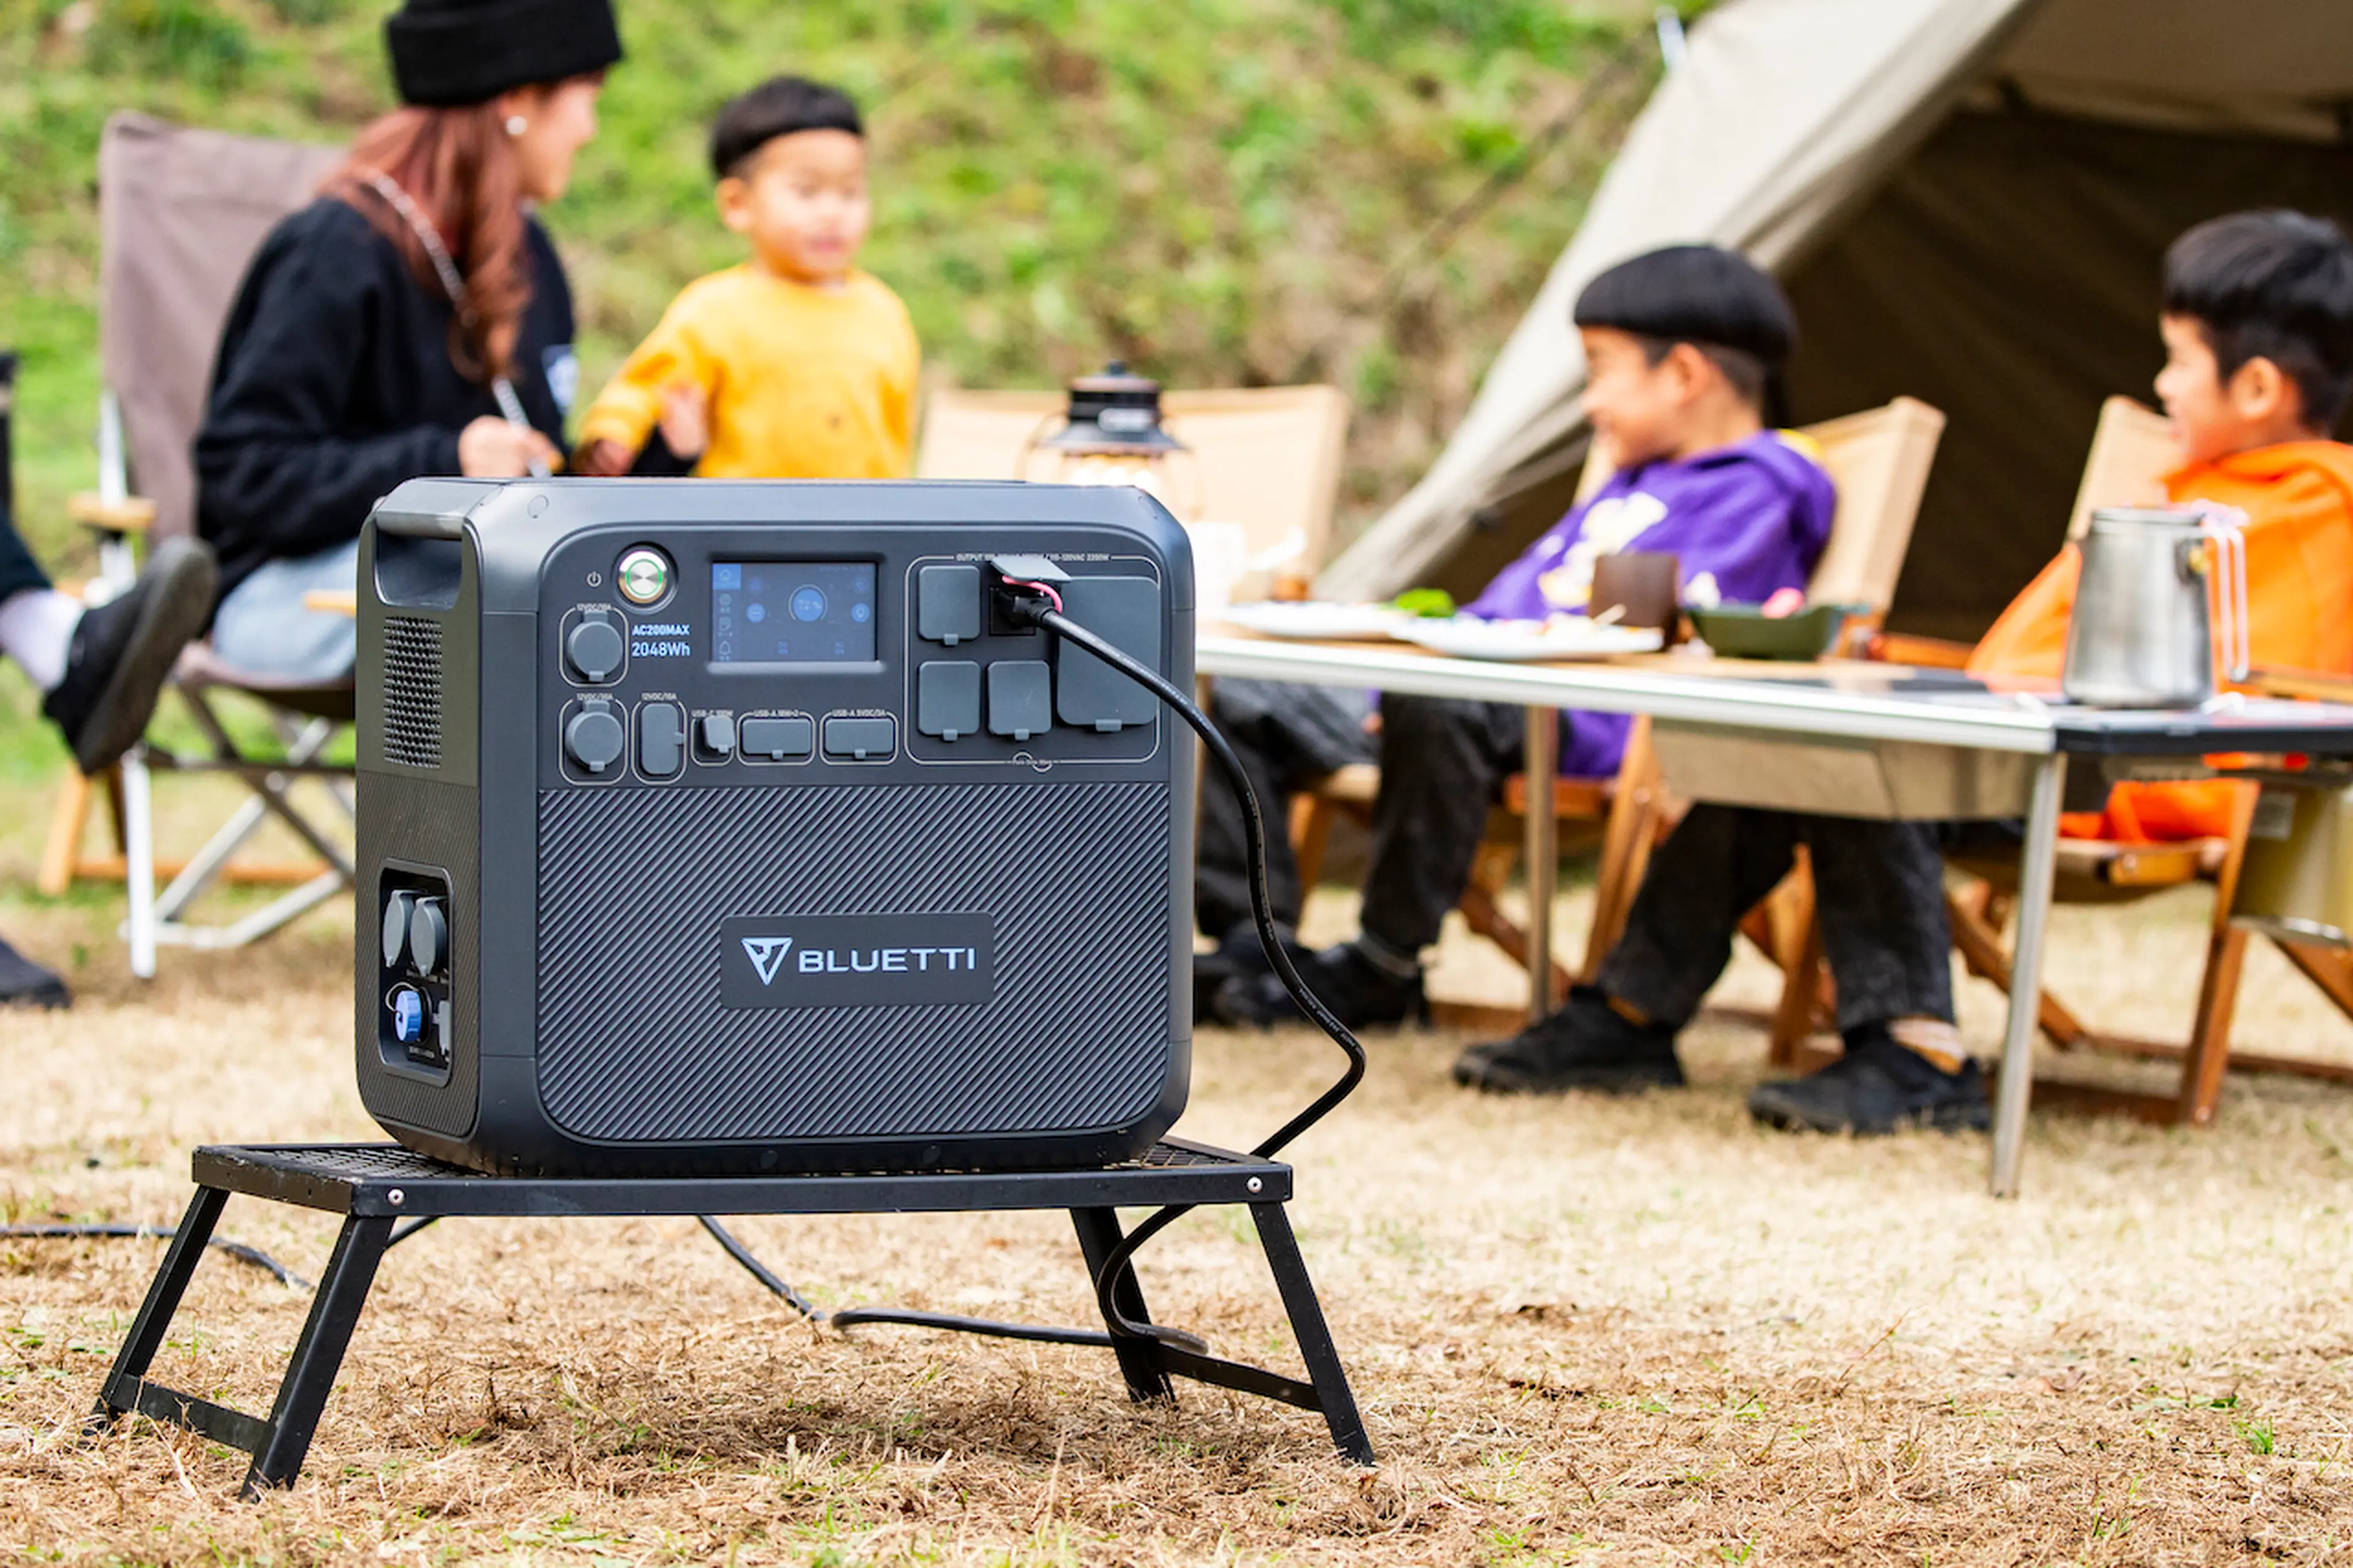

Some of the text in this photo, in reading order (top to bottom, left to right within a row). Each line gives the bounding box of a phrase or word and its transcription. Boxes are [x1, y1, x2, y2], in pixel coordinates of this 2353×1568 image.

[632, 624, 691, 635] AC200MAX
[632, 642, 691, 656] 2048Wh
[798, 947, 976, 973] BLUETTI
